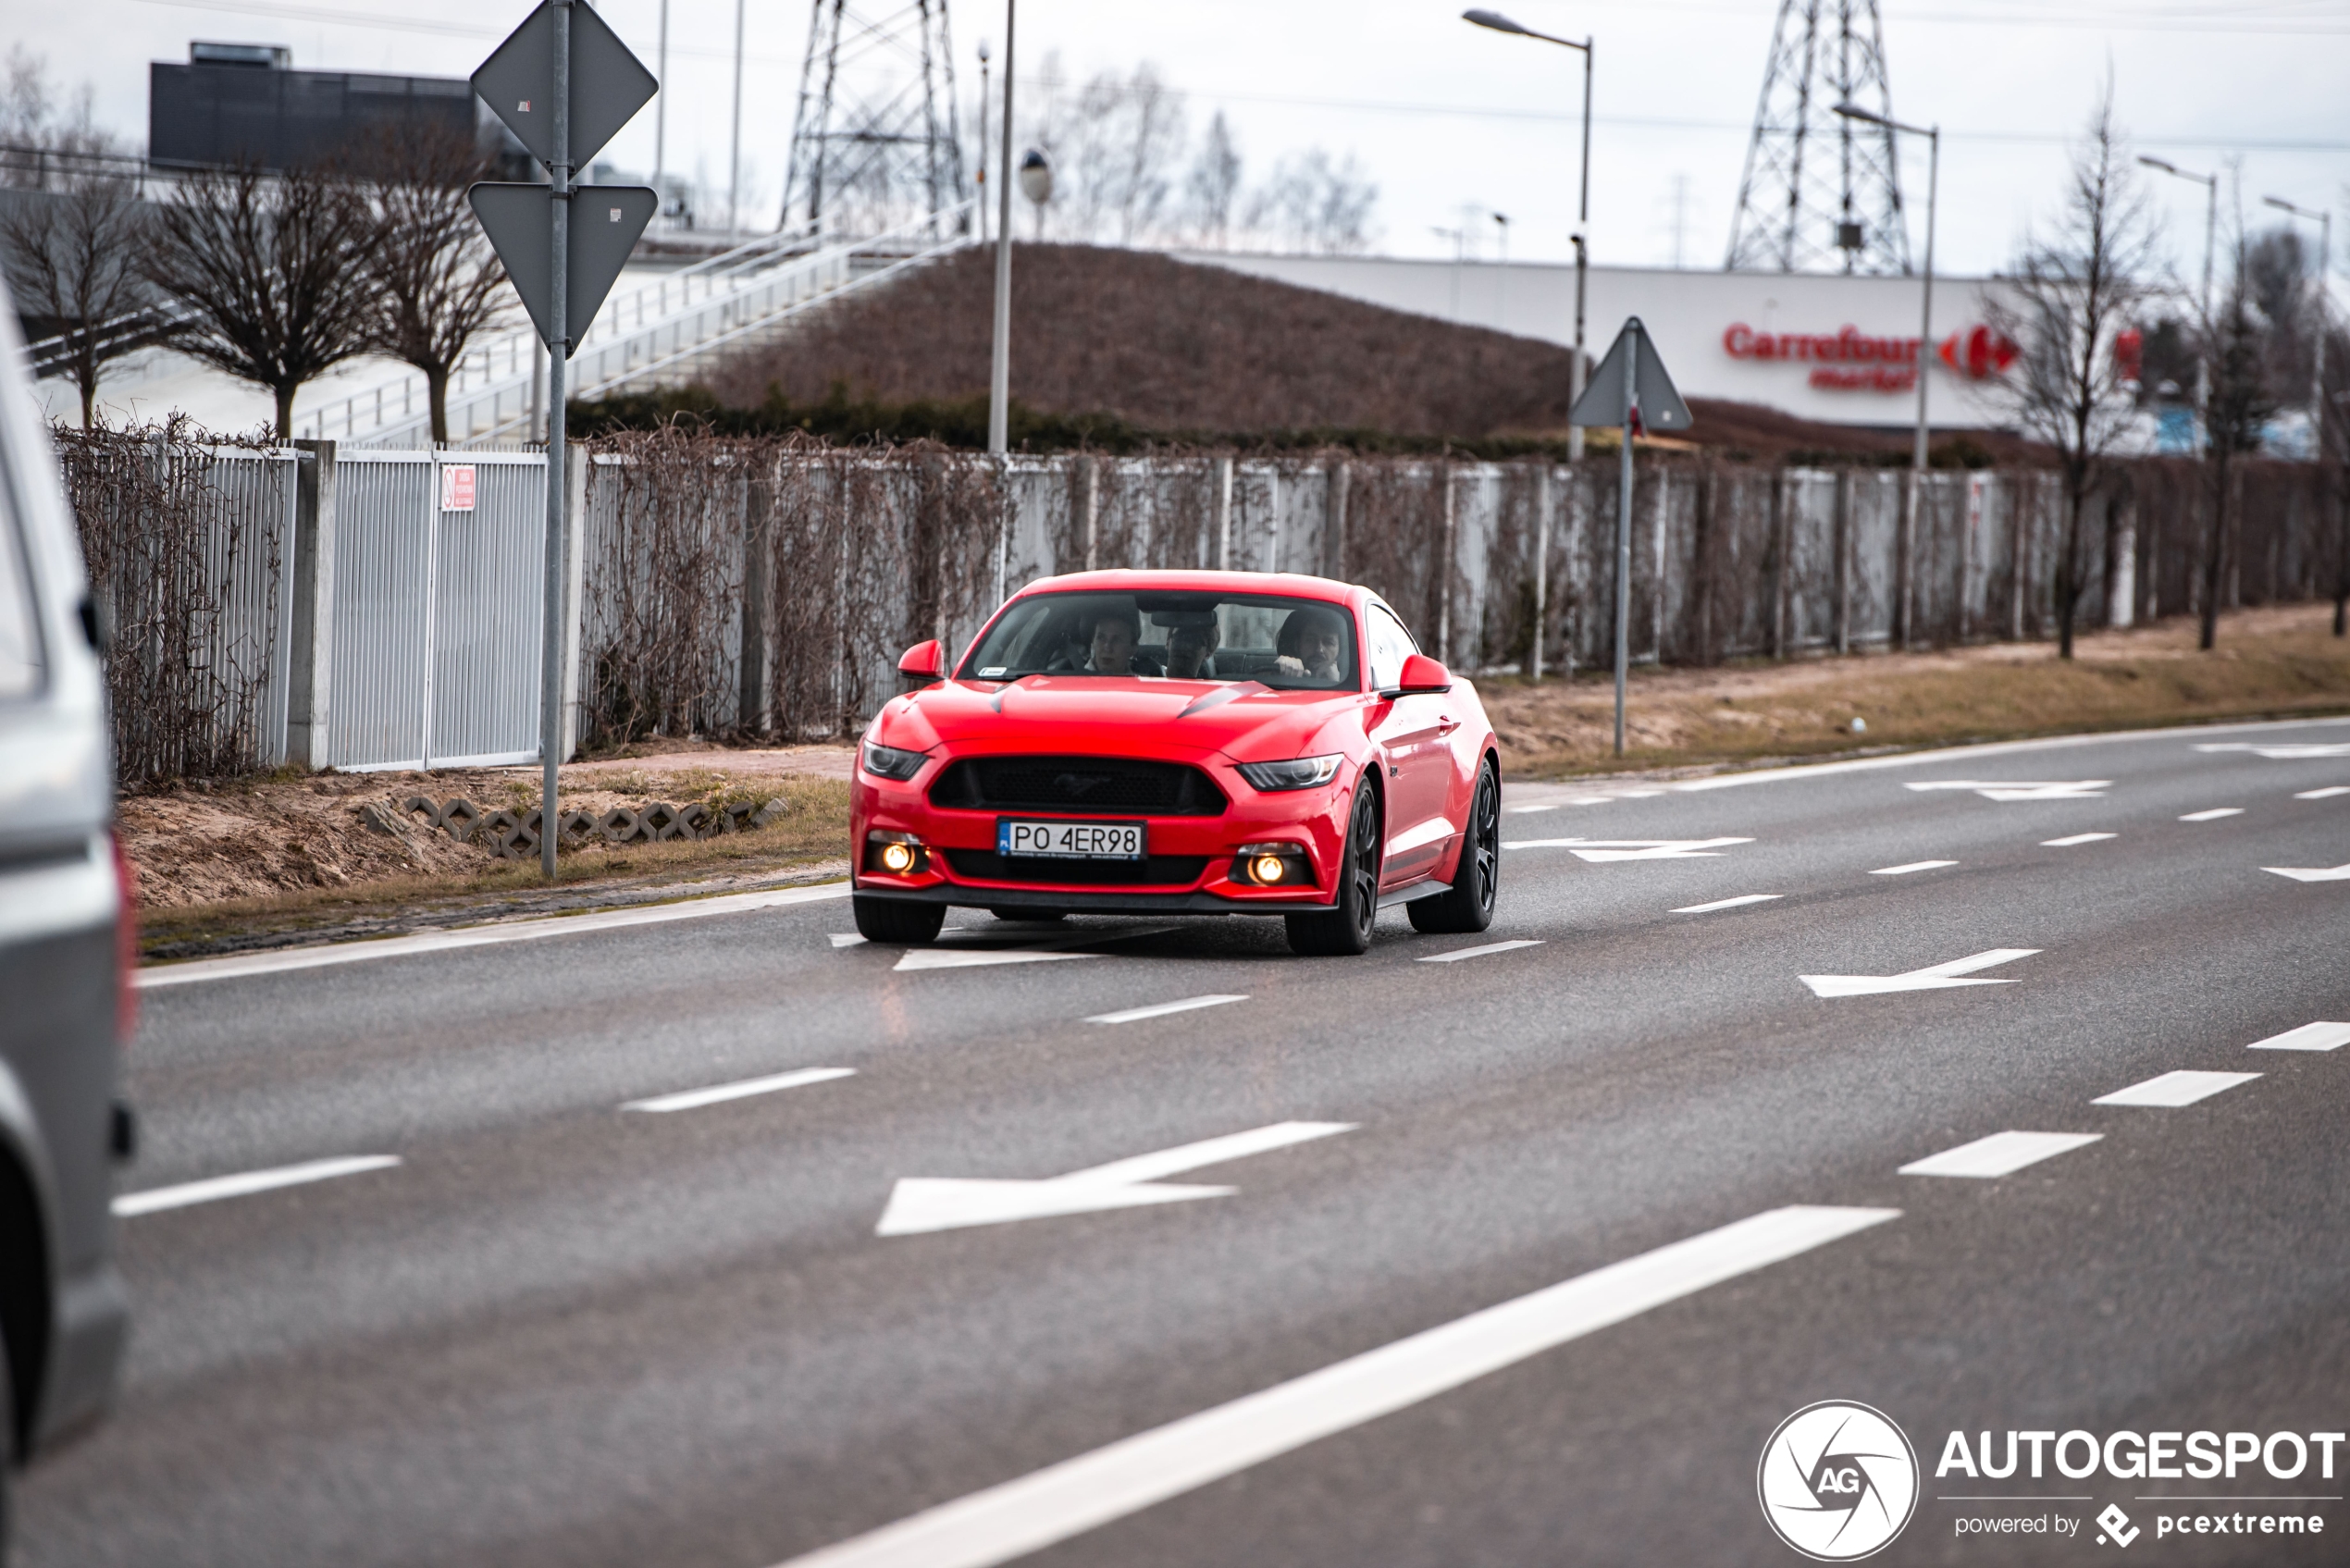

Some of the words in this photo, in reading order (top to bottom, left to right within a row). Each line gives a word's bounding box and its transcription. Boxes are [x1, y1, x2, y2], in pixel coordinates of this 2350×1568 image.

[1724, 323, 1923, 362] Carrefour
[1809, 366, 1917, 394] market
[1000, 839, 1008, 847] PL
[1015, 826, 1050, 850] PO
[1060, 828, 1137, 853] 4ER98
